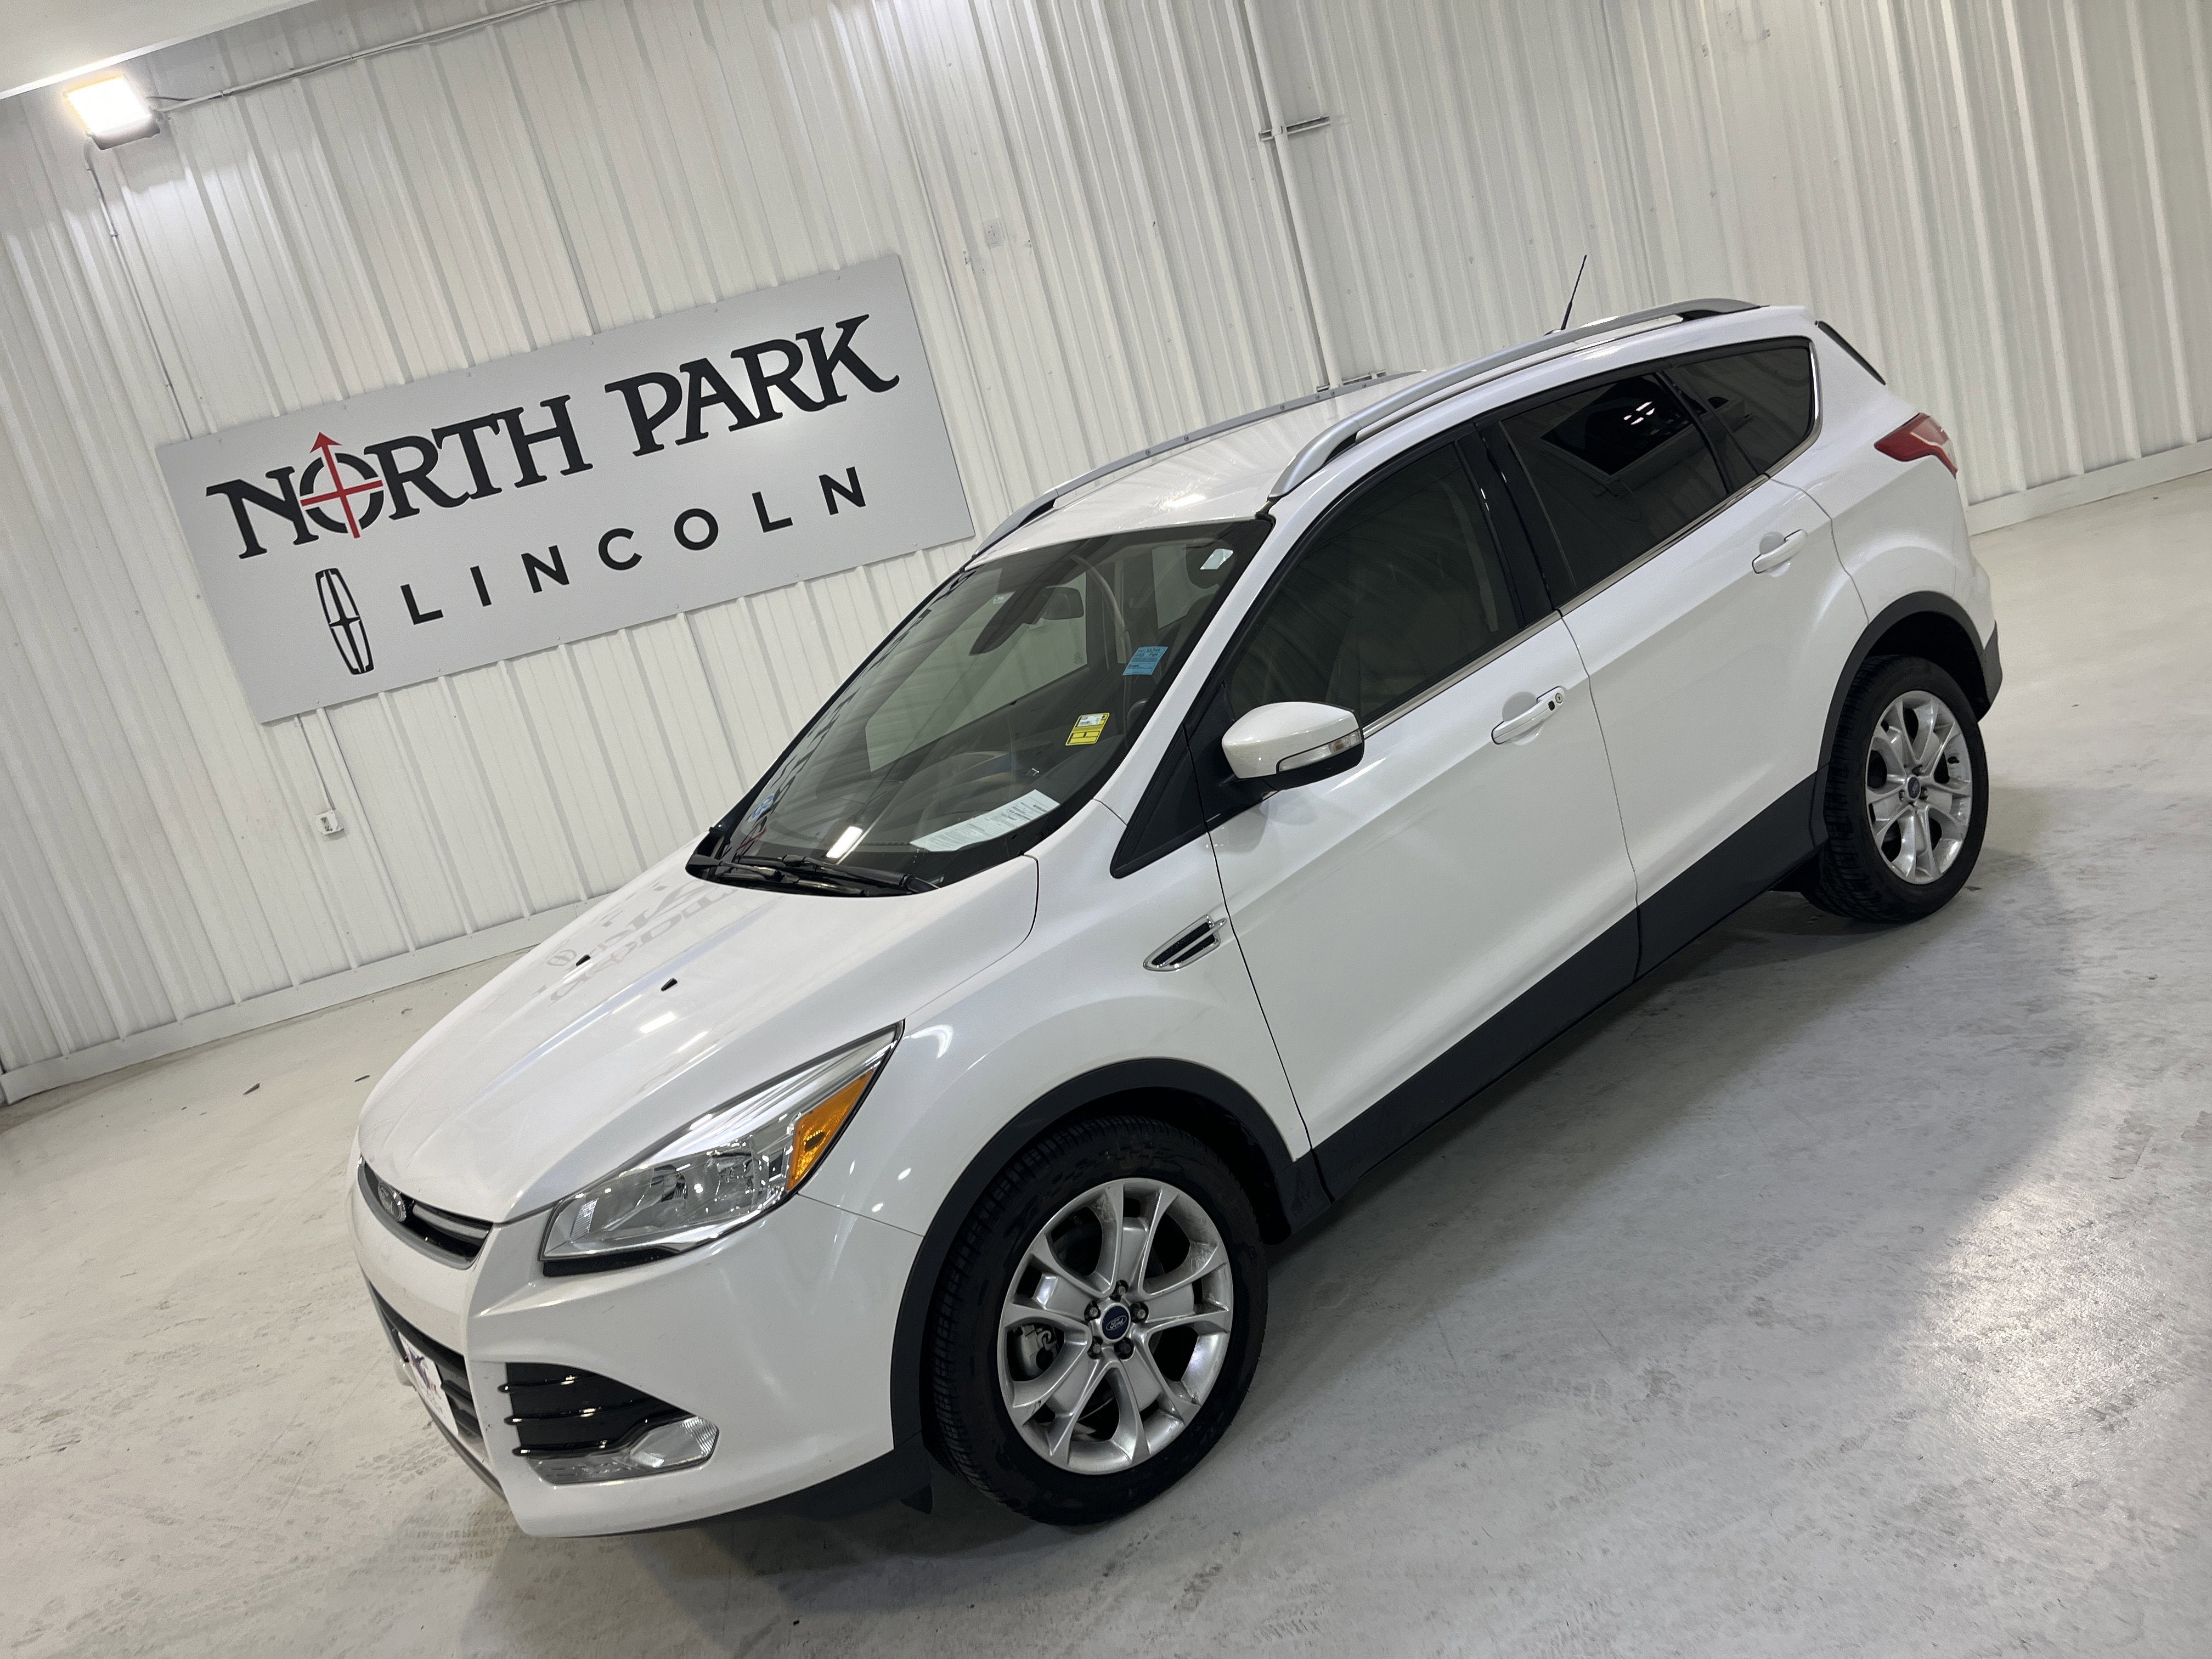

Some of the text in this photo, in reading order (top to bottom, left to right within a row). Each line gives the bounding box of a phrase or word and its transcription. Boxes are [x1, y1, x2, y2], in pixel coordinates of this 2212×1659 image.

[206, 314, 900, 559] NORTH PARK
[400, 466, 866, 625] LINCOLN
